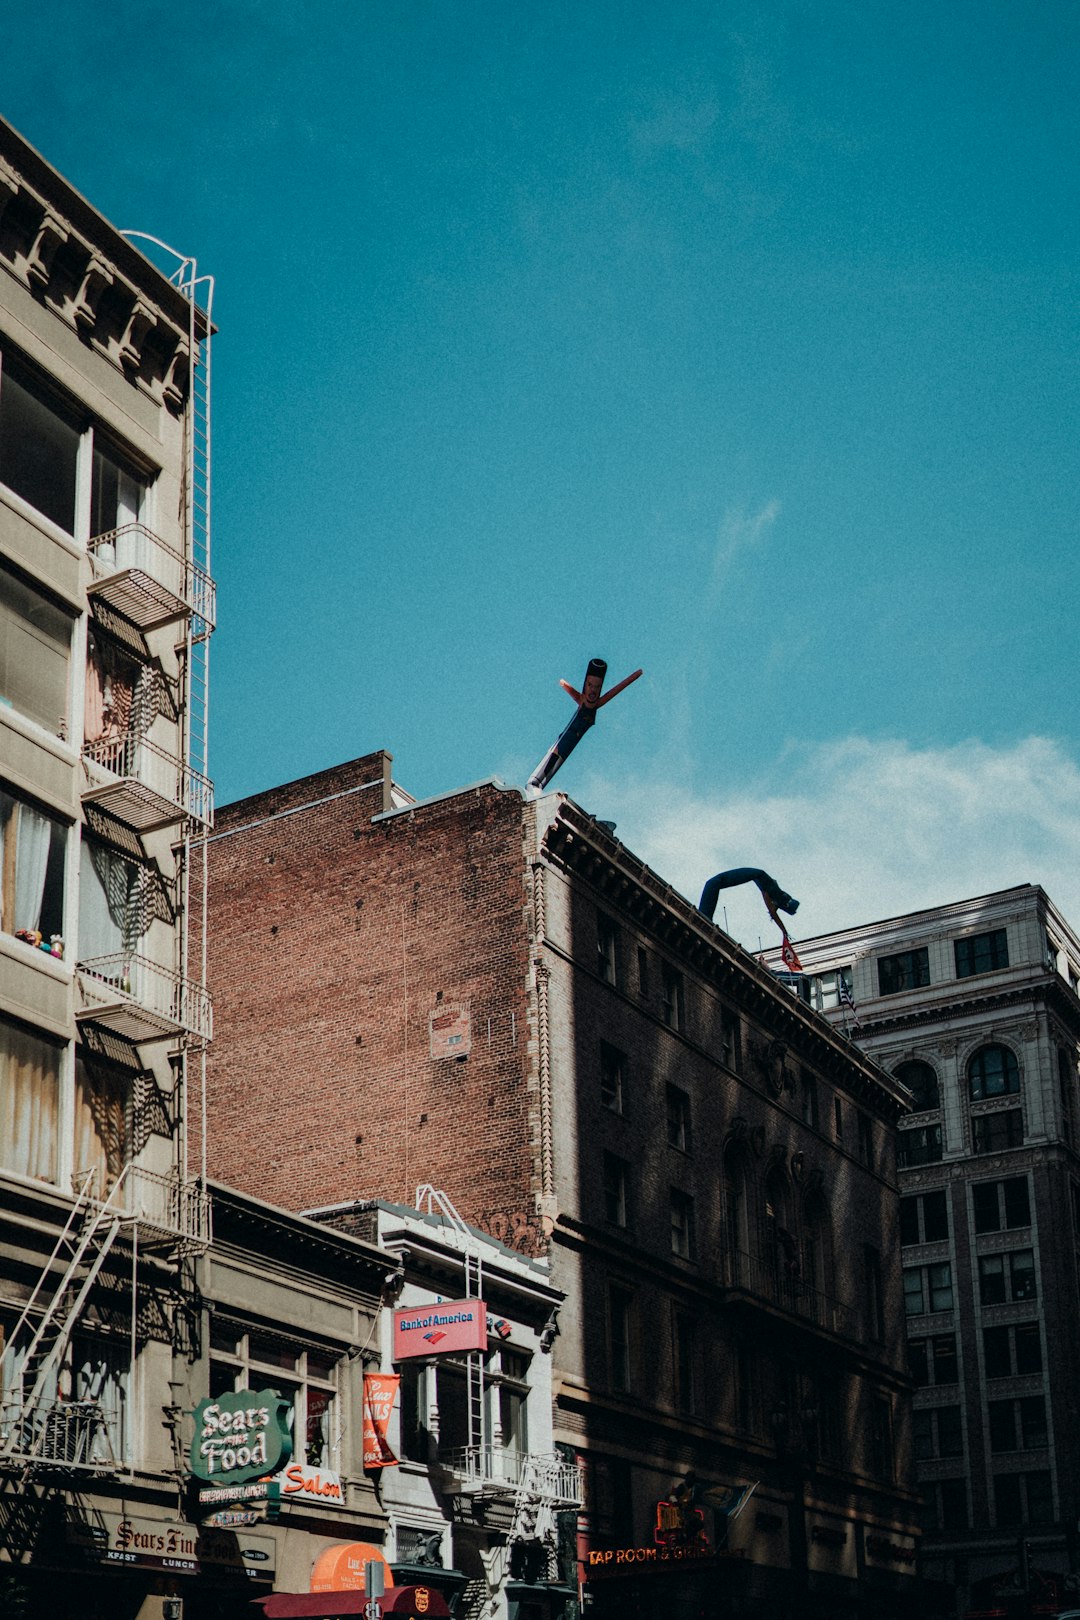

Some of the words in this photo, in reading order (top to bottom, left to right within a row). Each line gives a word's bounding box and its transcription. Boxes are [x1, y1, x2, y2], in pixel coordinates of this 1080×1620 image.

[400, 1318, 423, 1331] Bank
[422, 1316, 433, 1327] of
[433, 1312, 473, 1326] America
[201, 1404, 270, 1438] Sears
[200, 1432, 267, 1474] Food
[284, 1465, 340, 1498] Salon
[116, 1521, 164, 1555] Sears
[162, 1559, 195, 1569] LUNCH
[347, 1556, 360, 1569] Lux
[588, 1550, 614, 1567] TAP
[615, 1547, 657, 1564] ROOM
